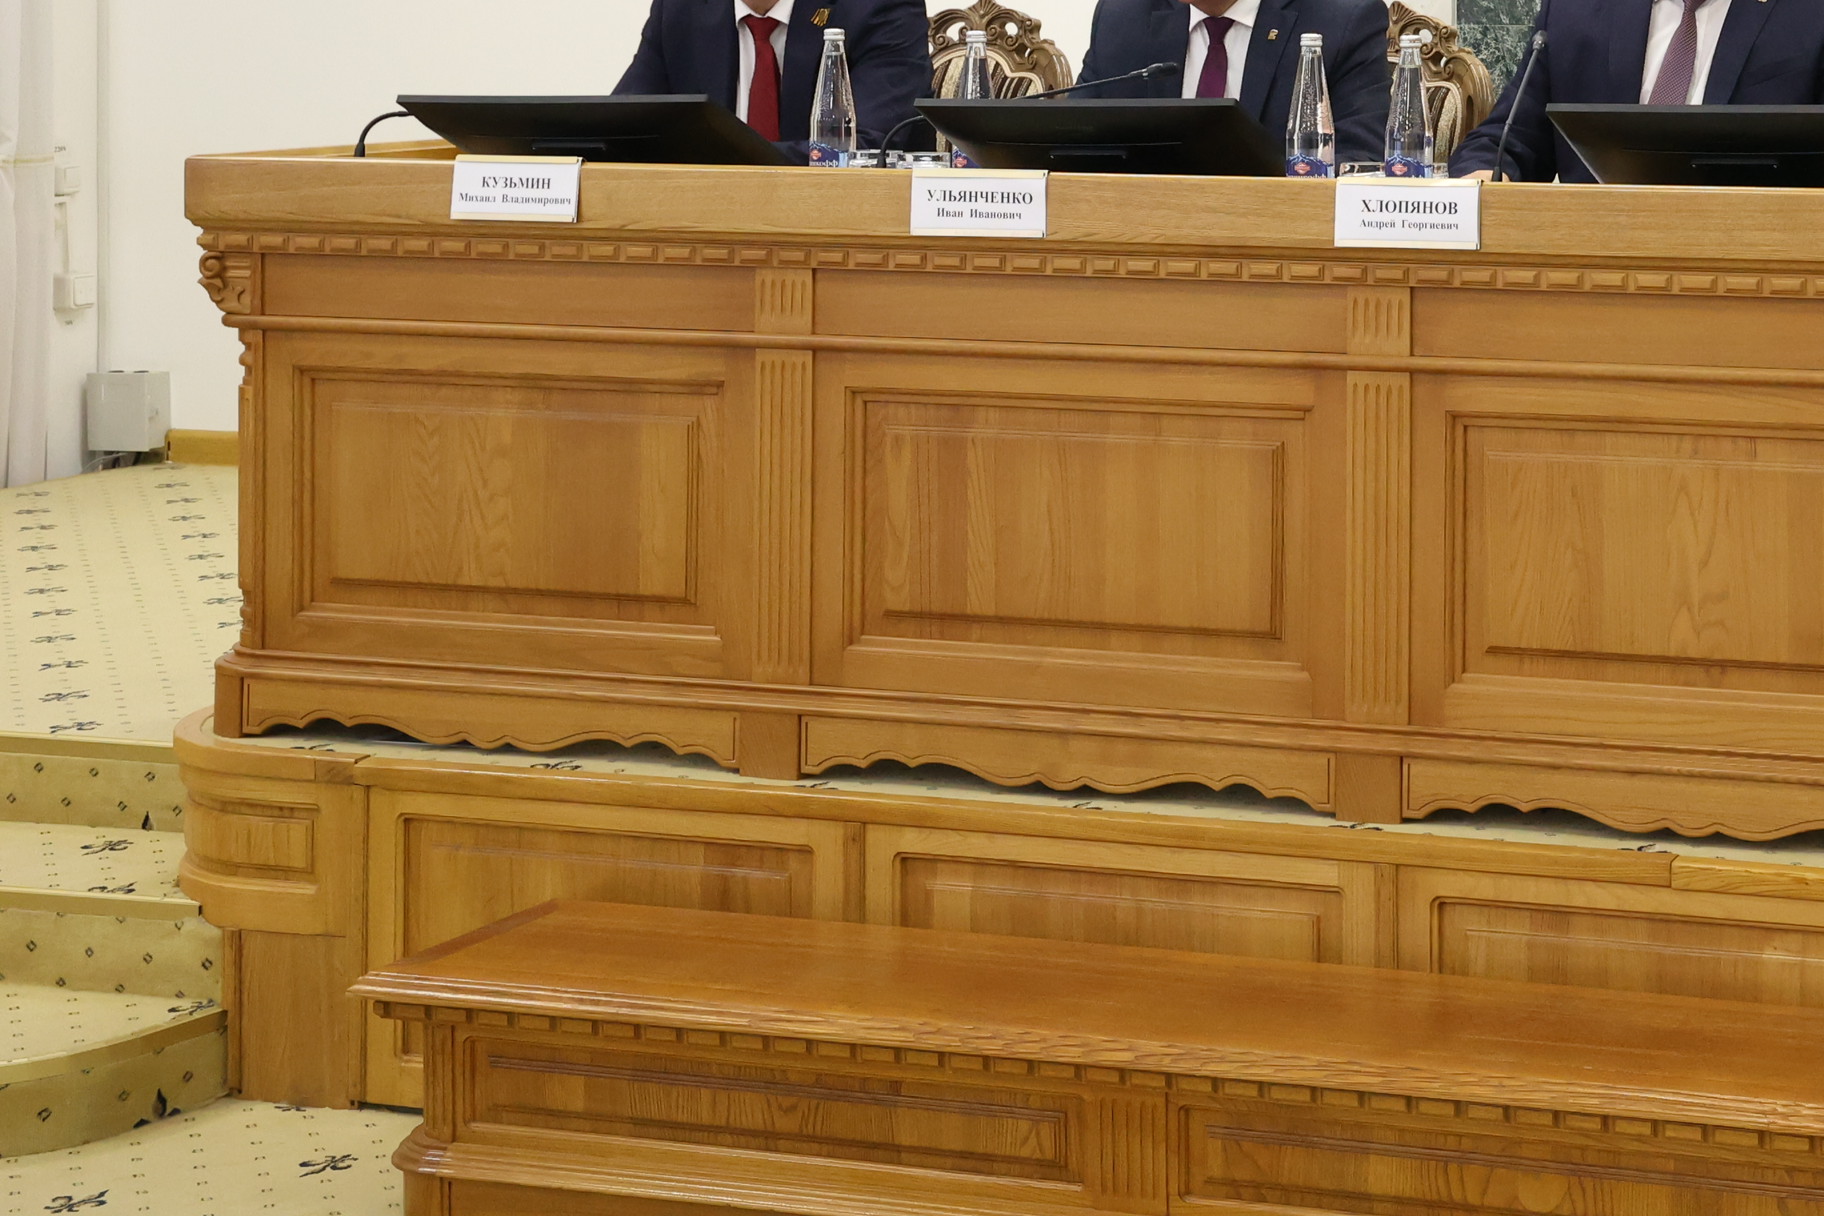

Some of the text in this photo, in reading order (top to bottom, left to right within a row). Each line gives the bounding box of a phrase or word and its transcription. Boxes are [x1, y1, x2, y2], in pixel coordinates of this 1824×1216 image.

[481, 176, 552, 190] КУЗЬМИН
[458, 192, 571, 207] Михаил Владимирович
[927, 189, 1033, 205] УЛЬЯНЧЕНКО
[937, 207, 1022, 220] Иван Иванович
[1361, 199, 1458, 215] ХЛОПЯНОВ
[1359, 218, 1459, 231] Андрей Георгиевич
